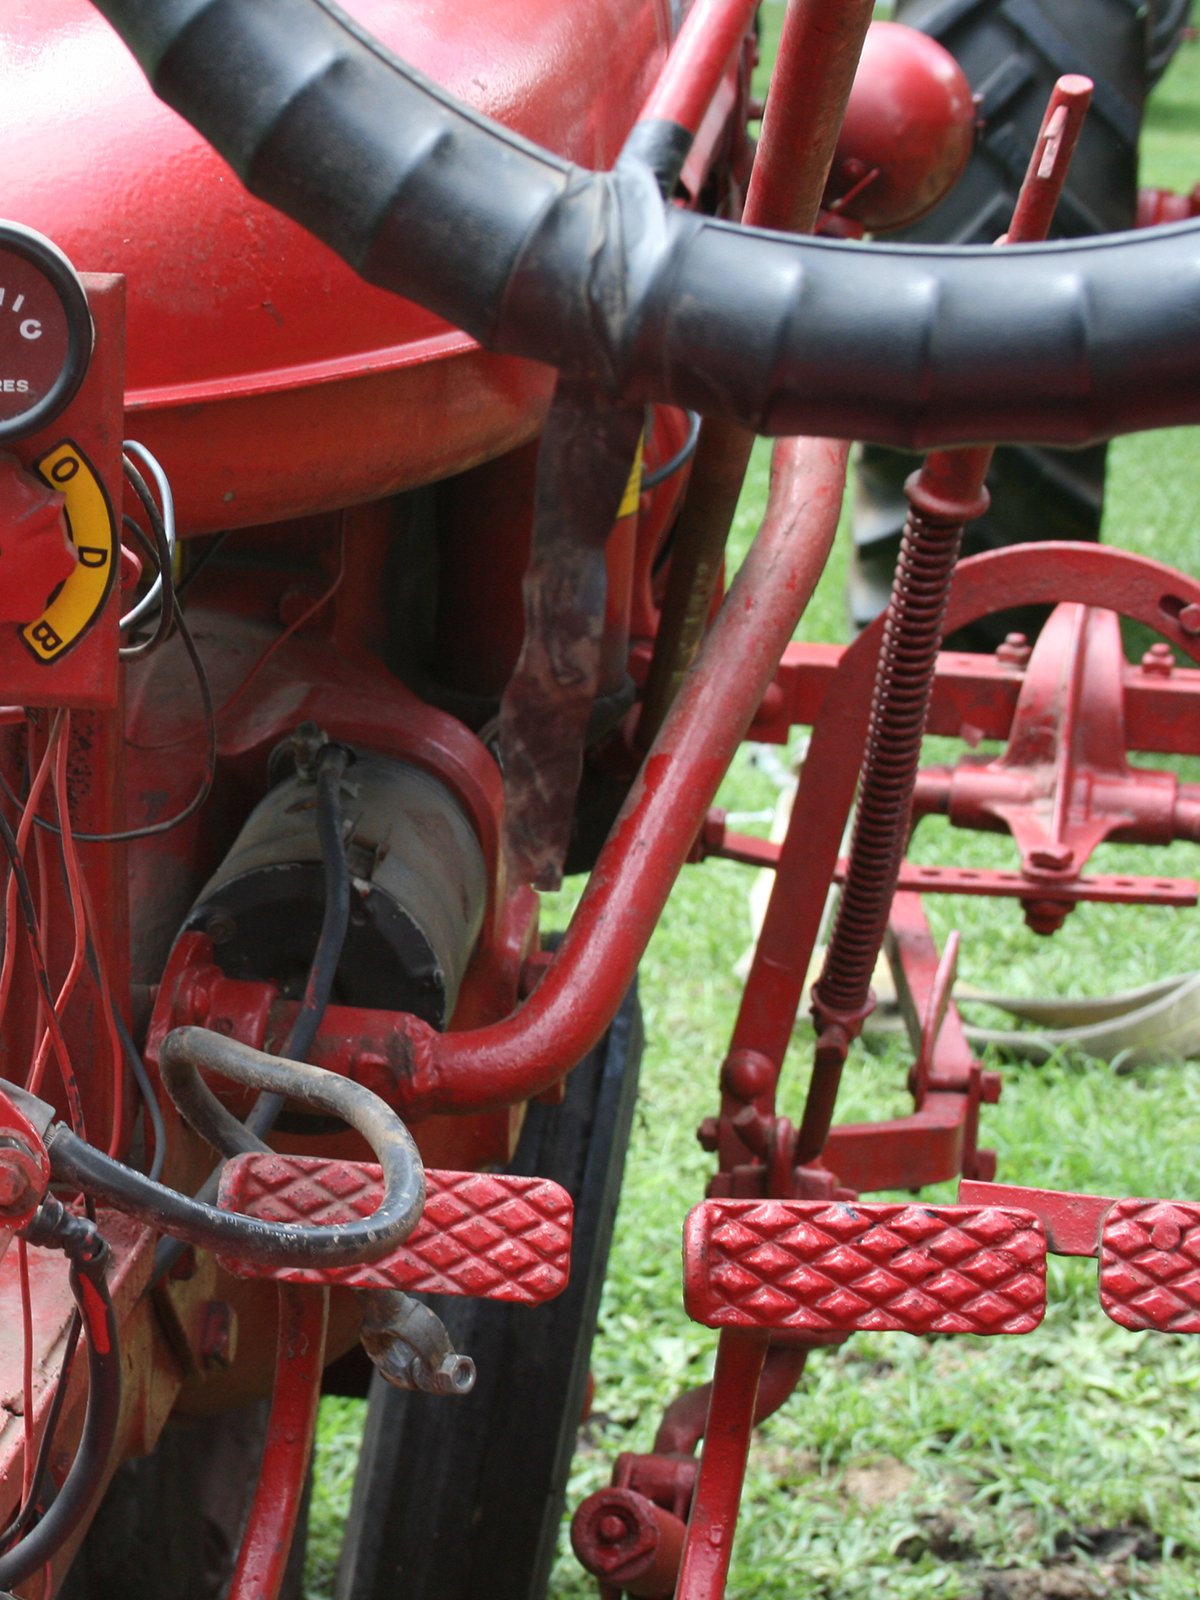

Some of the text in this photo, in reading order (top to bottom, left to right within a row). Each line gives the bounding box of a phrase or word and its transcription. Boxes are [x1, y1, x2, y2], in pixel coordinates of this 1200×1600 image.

[19, 319, 43, 340] C
[78, 545, 108, 568] D
[31, 620, 63, 652] B
